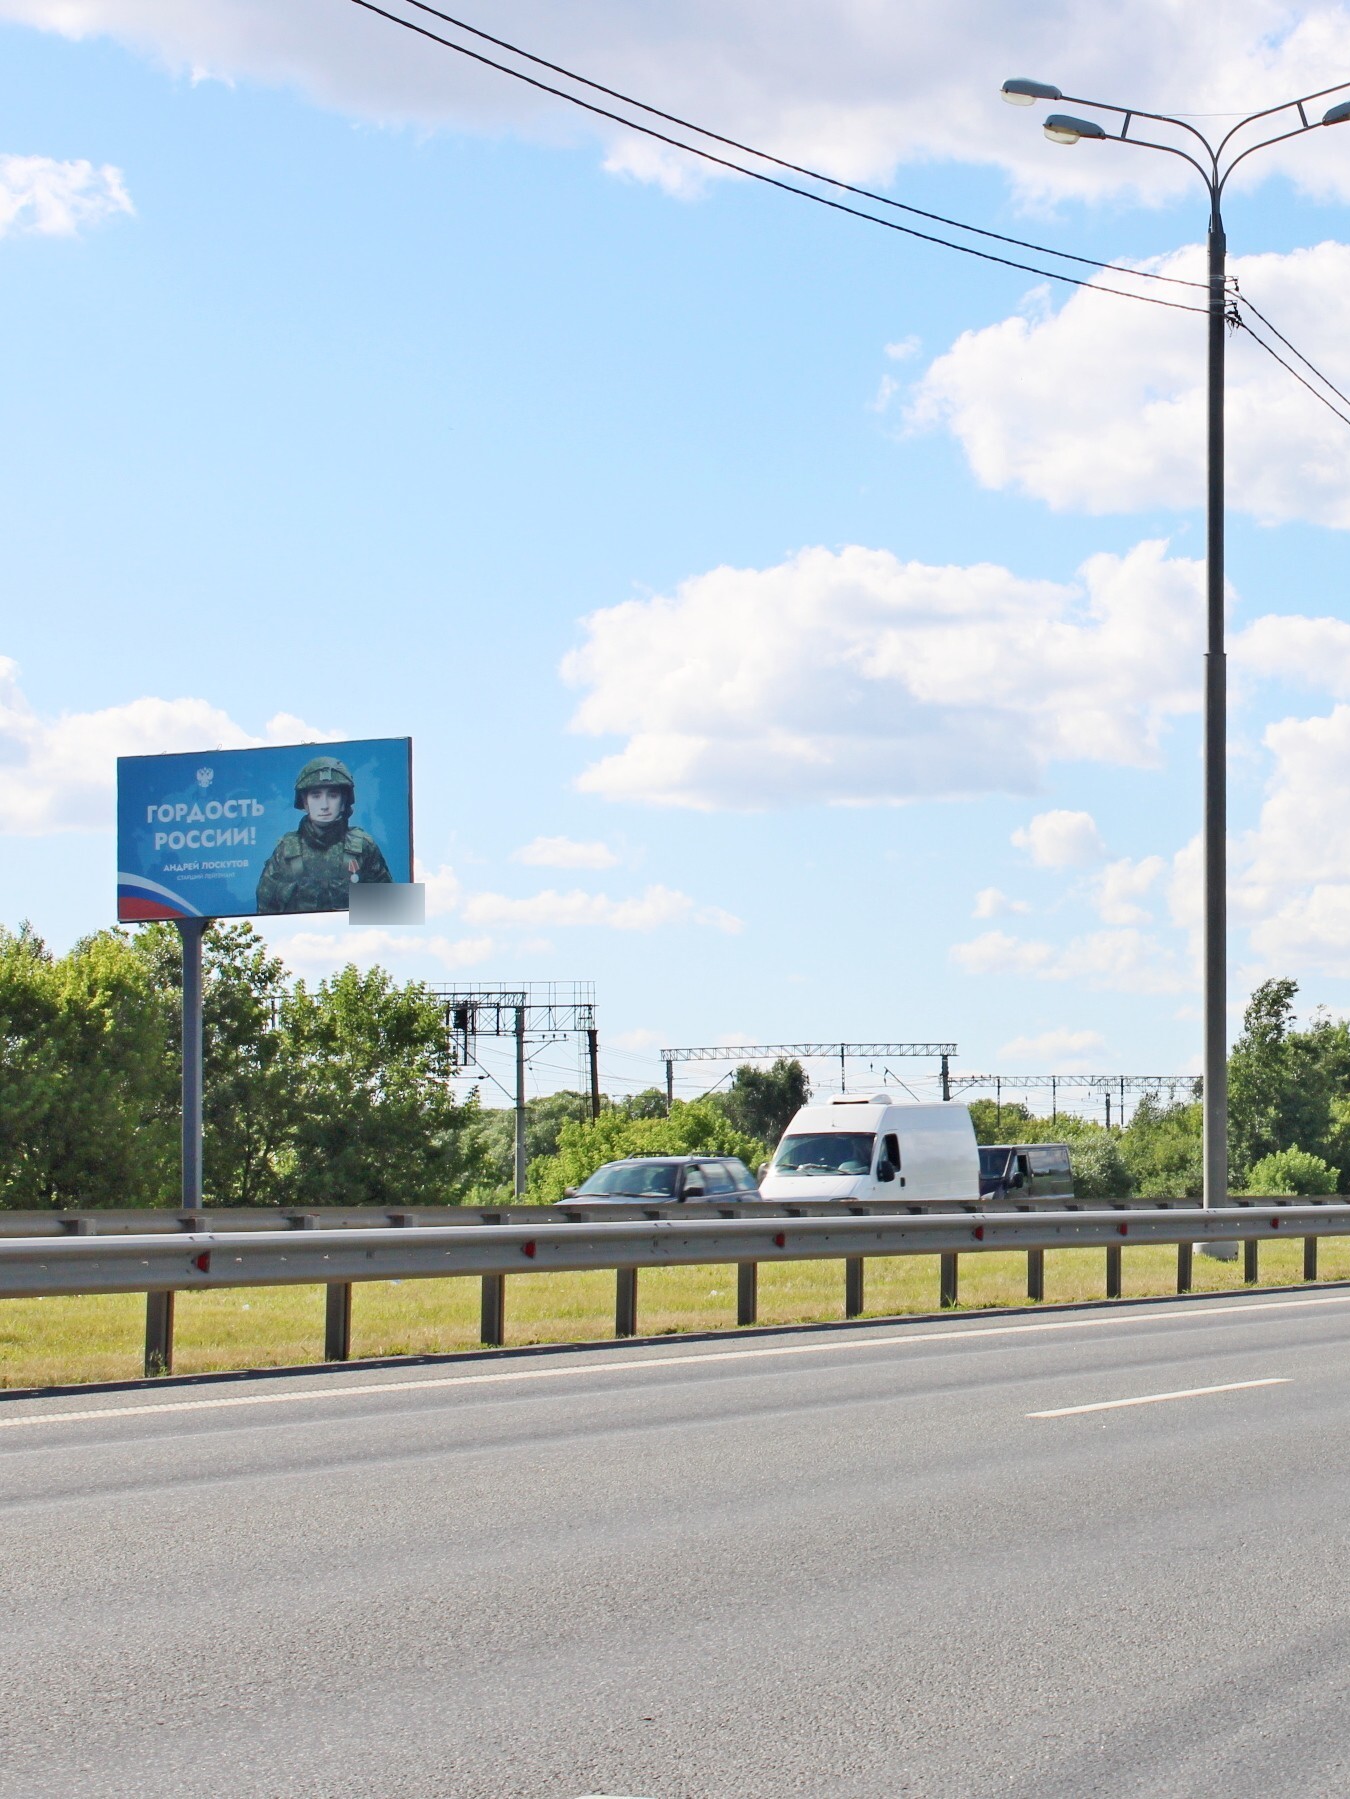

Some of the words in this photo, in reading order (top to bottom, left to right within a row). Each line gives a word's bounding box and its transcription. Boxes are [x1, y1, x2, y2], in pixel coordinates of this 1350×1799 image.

[147, 799, 265, 823] ГОРДОСТЬ
[155, 827, 257, 850] РОССИИ!
[163, 861, 199, 872] АНДРЕЙ
[201, 859, 249, 870] ЛОСКУТОВ
